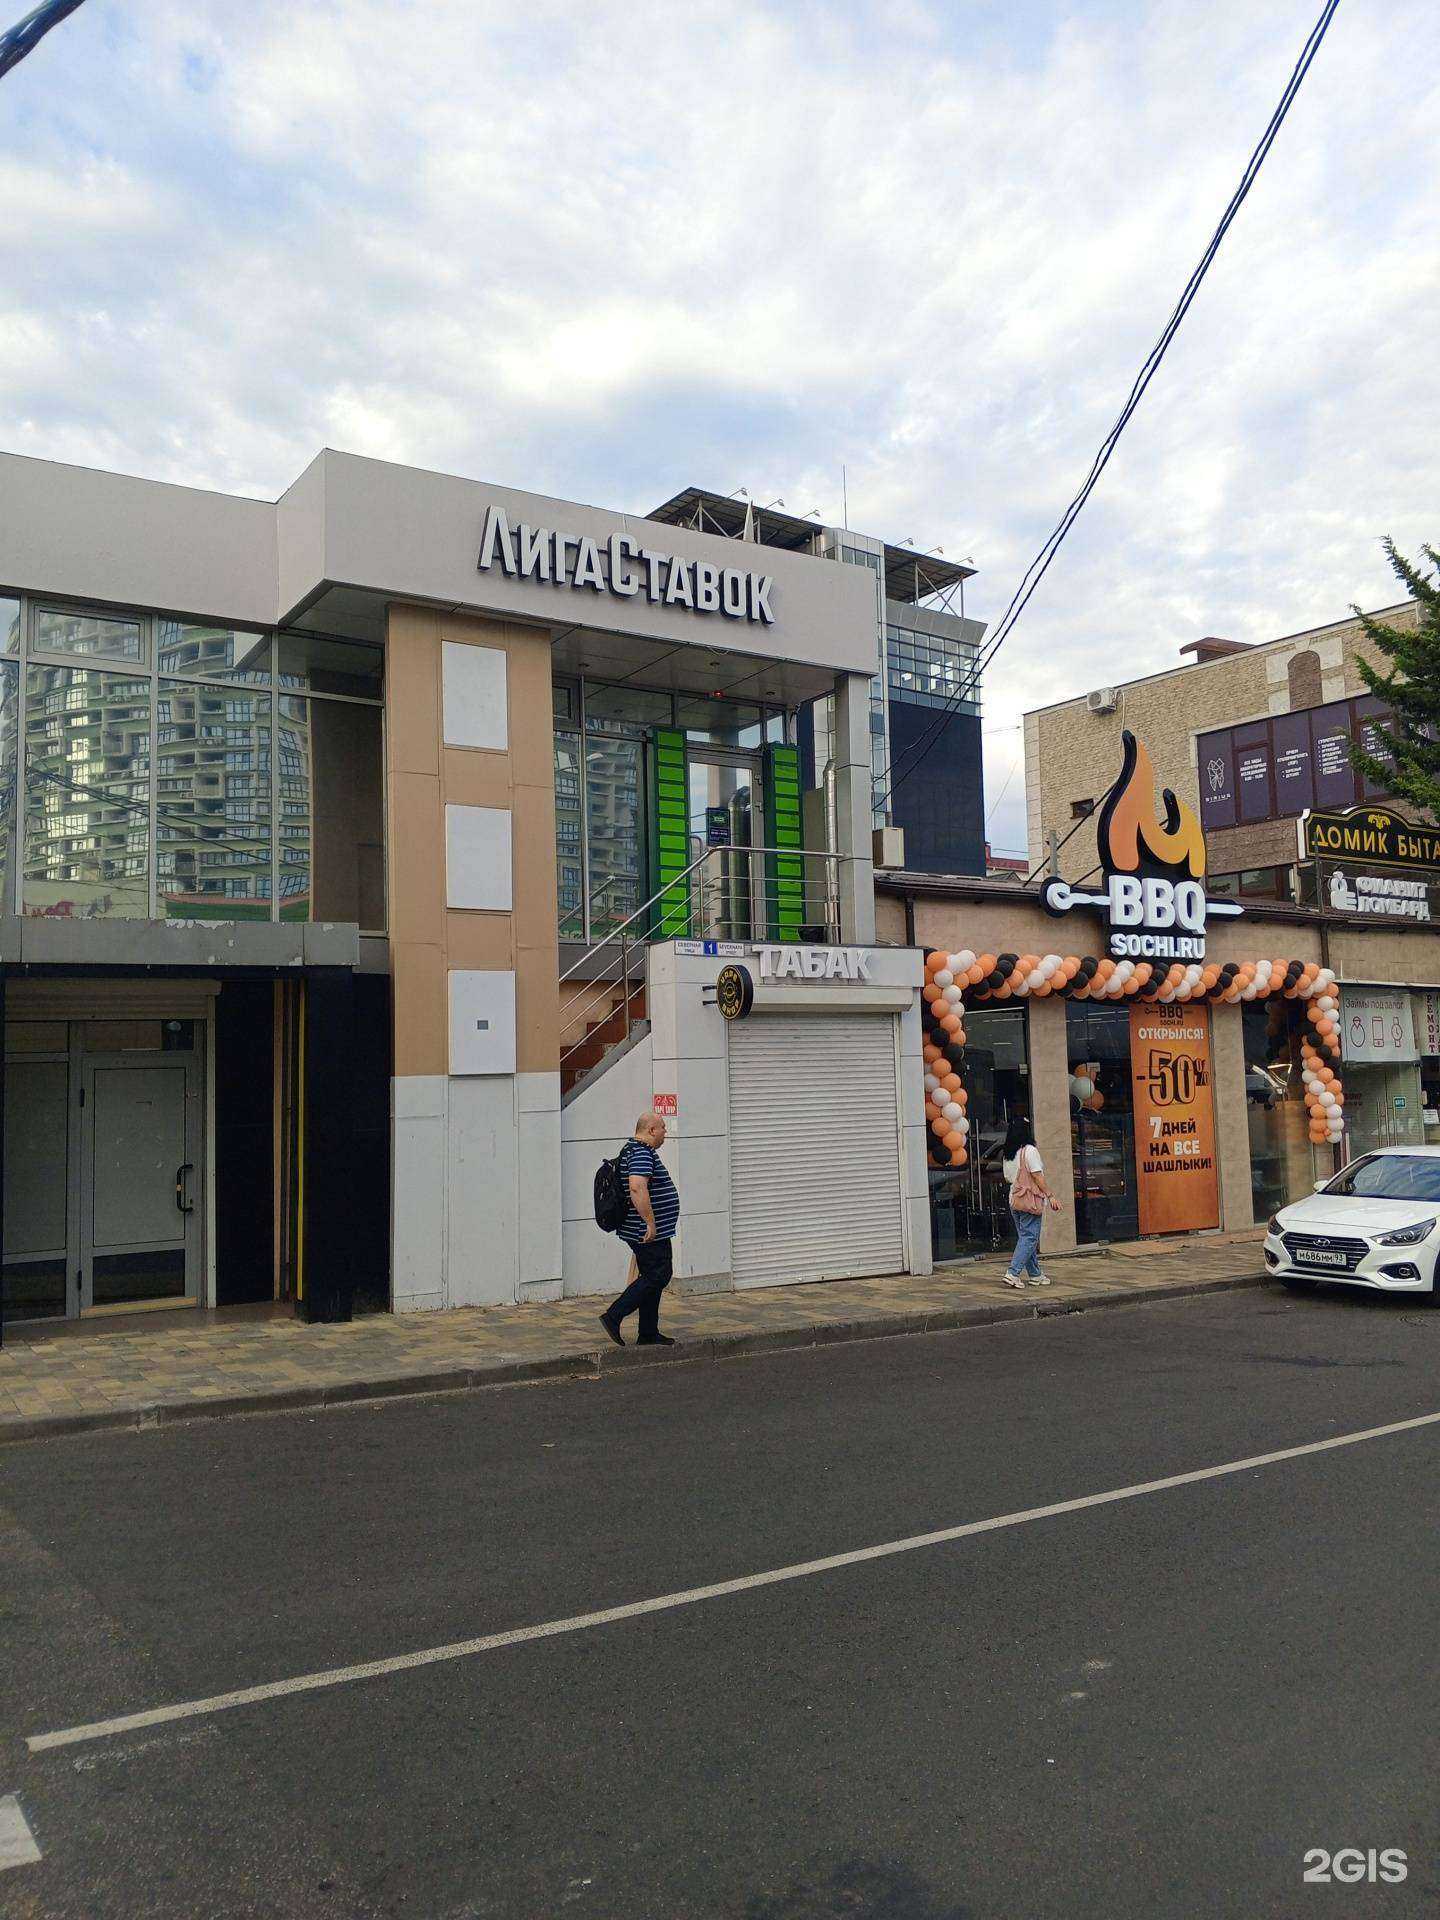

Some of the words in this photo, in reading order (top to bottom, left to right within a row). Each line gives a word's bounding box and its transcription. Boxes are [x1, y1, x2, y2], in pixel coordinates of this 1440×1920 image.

[1312, 824, 1388, 854] ДОМИК
[1109, 875, 1206, 935] BBQ
[708, 943, 714, 954] 1
[1110, 933, 1206, 959] SOCHI.RU
[752, 944, 873, 979] ТАБАК
[1159, 1005, 1183, 1019] BBQ
[1138, 1027, 1204, 1040] ОТКРЫЛСЯ!
[1426, 994, 1436, 1054] РЕМОНТ
[1136, 1048, 1209, 1107] -50%
[1161, 1118, 1197, 1137] ДНЕЙ
[1149, 1142, 1170, 1157] НА
[1173, 1139, 1201, 1156] ВСЕ
[1143, 1157, 1212, 1173] ШАШЛЫКИ!
